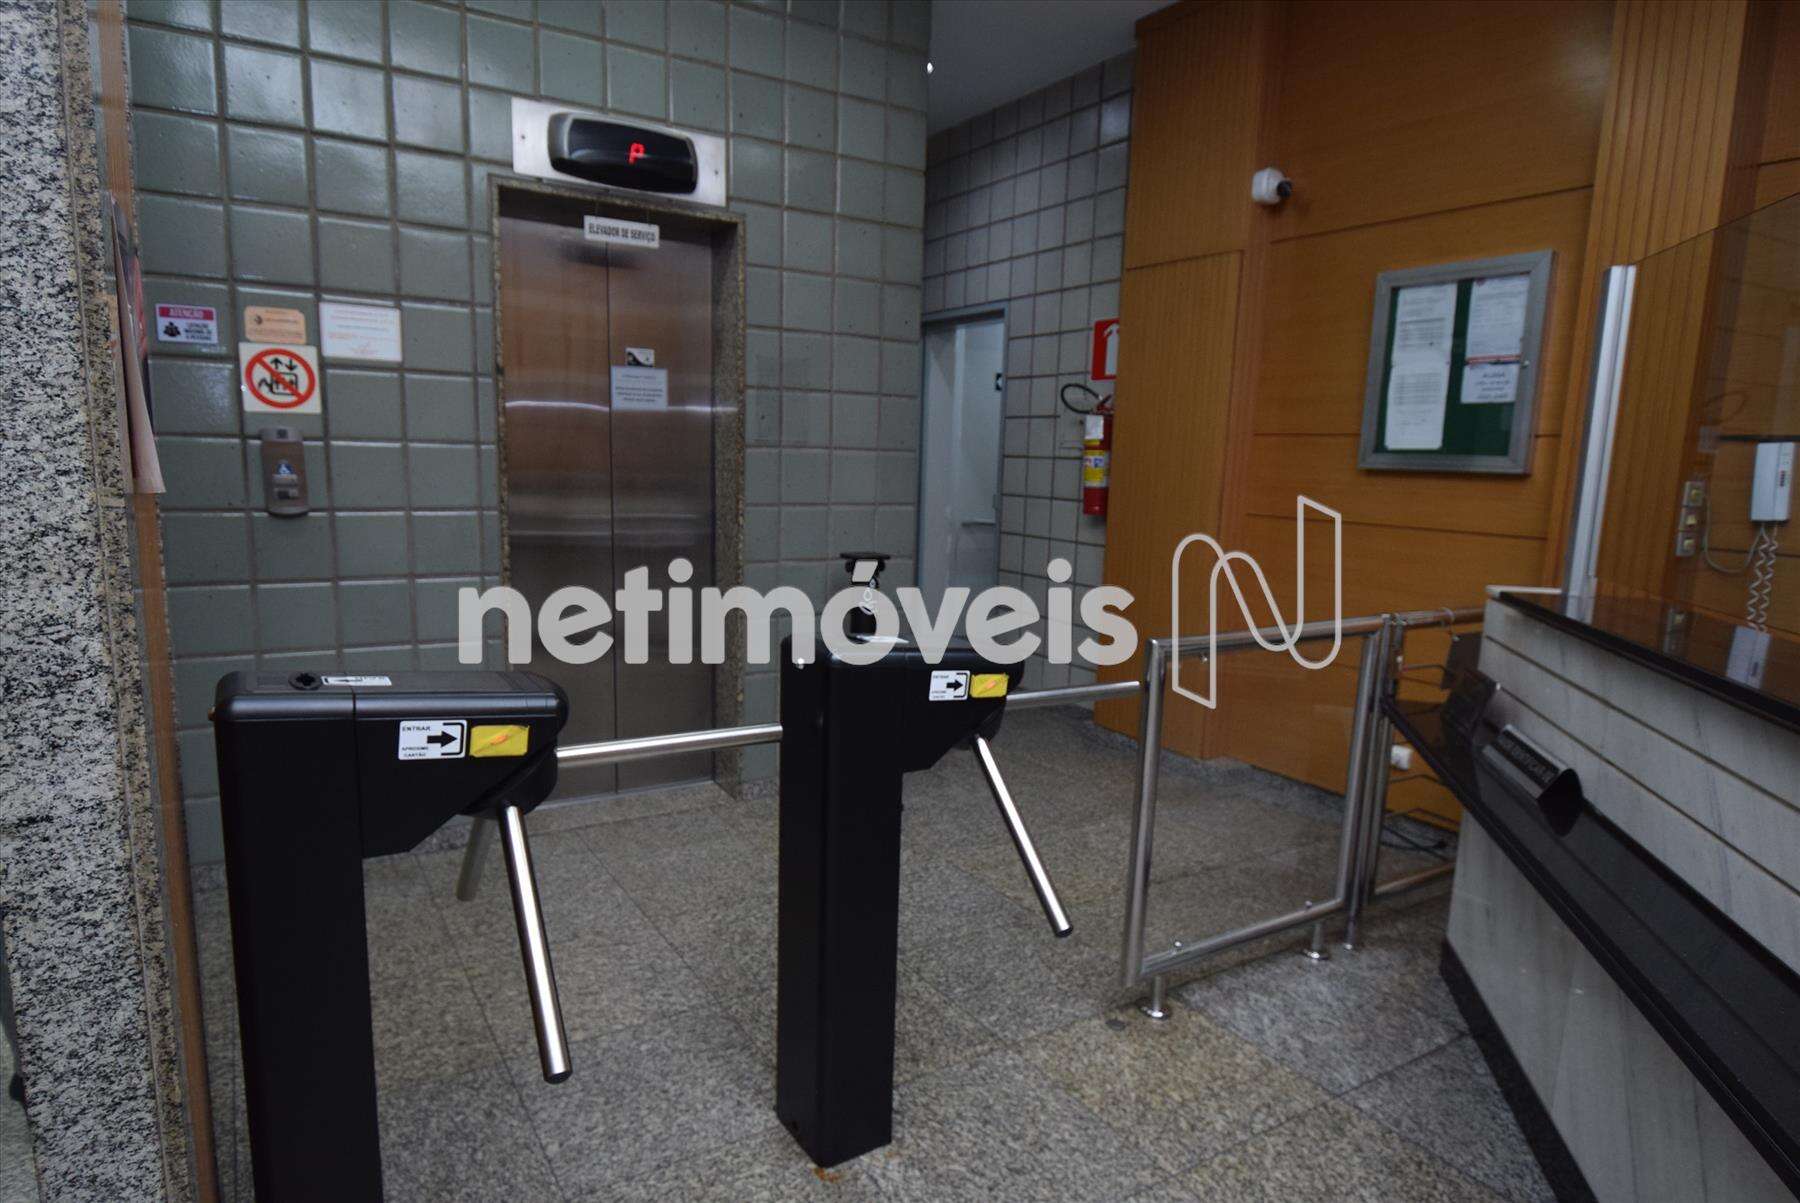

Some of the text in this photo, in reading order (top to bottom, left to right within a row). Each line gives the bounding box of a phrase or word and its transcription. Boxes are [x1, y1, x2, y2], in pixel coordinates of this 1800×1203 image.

[628, 142, 645, 165] P
[588, 222, 656, 243] ELEVADOR DE SERVIÇO
